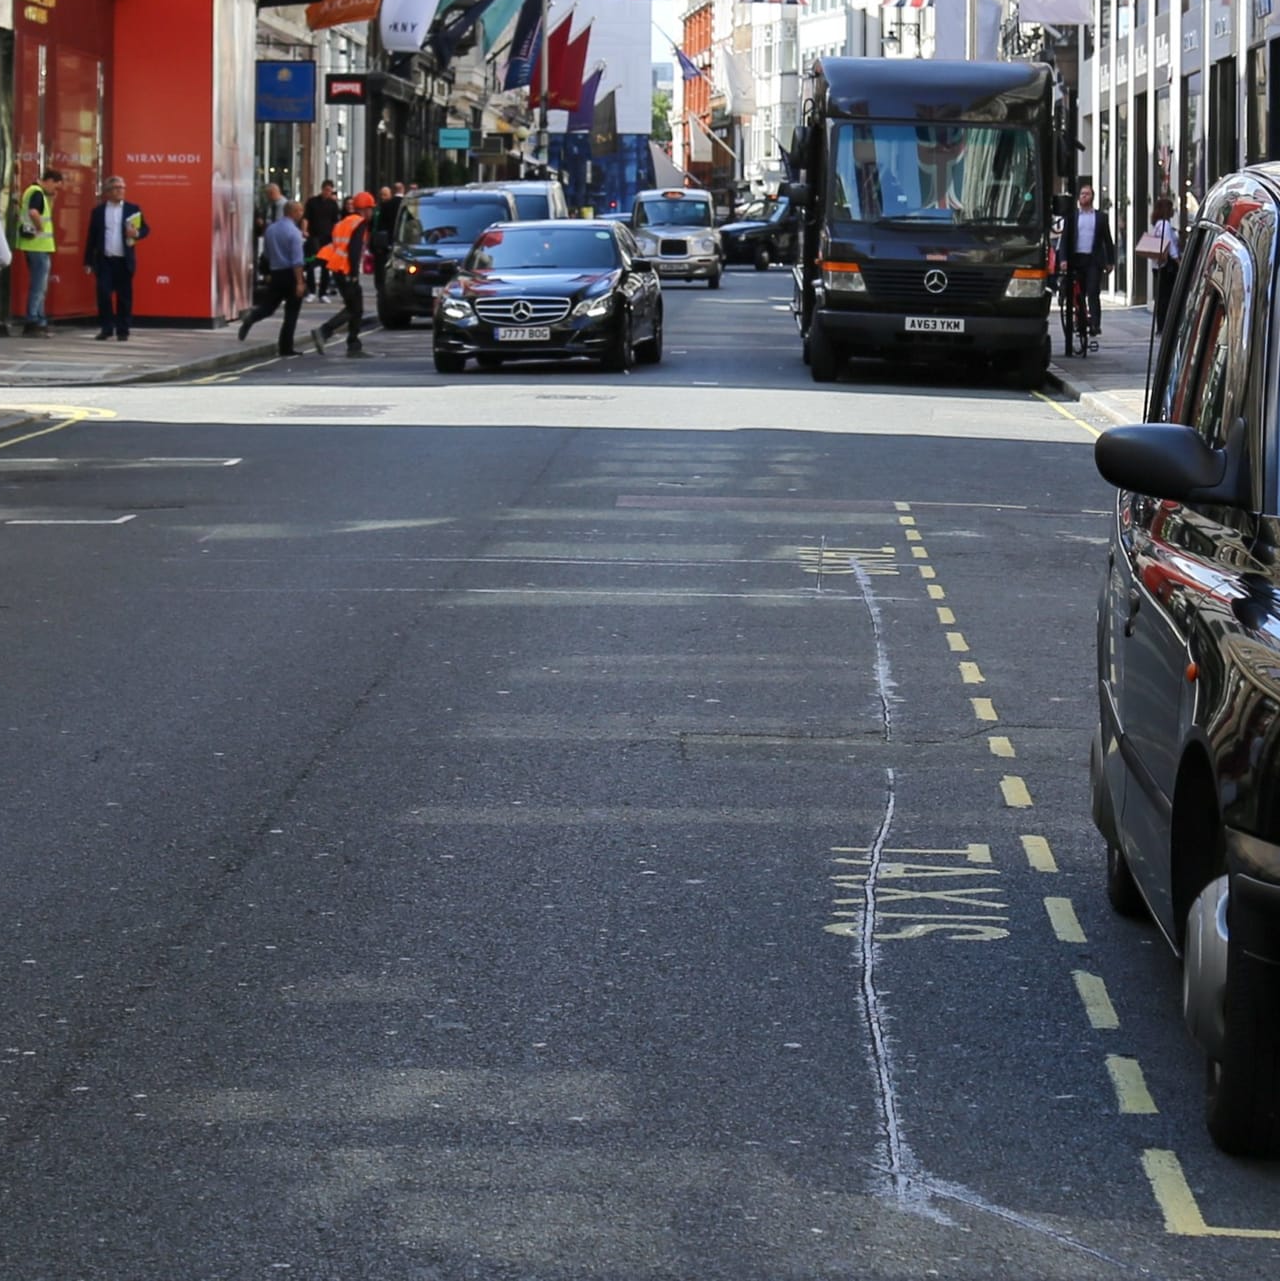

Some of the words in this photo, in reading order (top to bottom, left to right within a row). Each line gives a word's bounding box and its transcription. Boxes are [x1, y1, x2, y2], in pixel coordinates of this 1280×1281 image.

[126, 153, 163, 163] NIRAV
[167, 153, 201, 163] MODI
[910, 319, 937, 330] AV63
[501, 328, 525, 339] J777
[821, 843, 1011, 941] TAXIS
